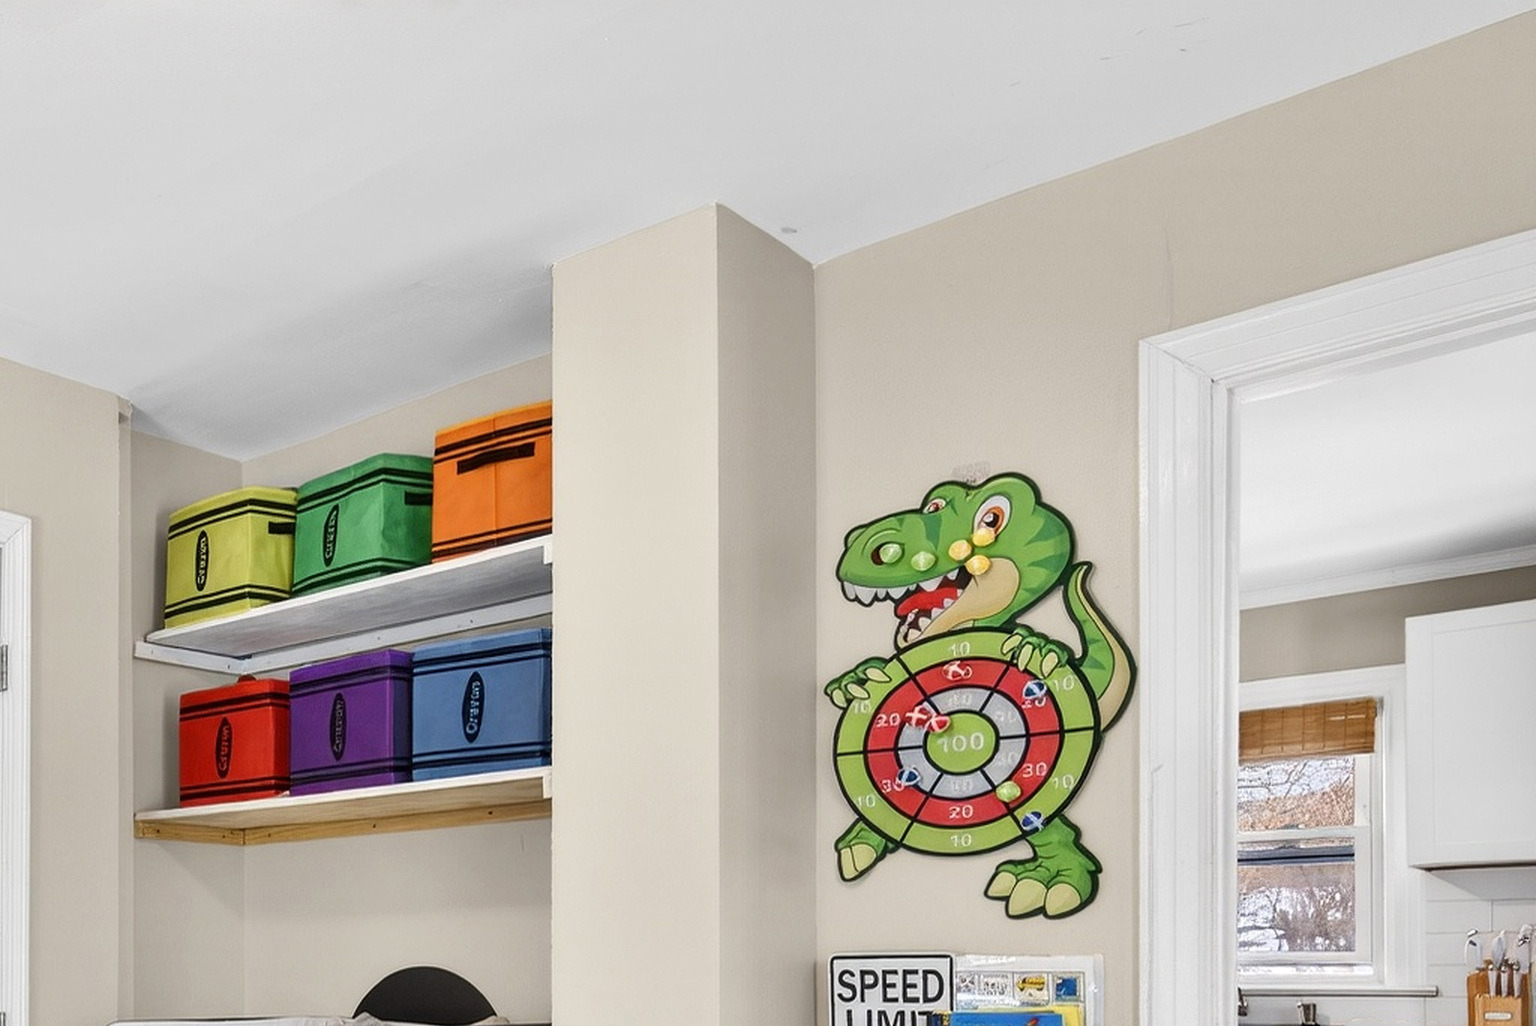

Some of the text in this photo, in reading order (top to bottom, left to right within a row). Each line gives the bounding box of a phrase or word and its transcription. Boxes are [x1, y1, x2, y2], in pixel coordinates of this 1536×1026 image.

[949, 641, 971, 657] 10
[1053, 675, 1075, 692] 10
[875, 712, 901, 728] 20
[937, 732, 984, 753] 100
[1022, 762, 1048, 778] 30
[1052, 774, 1075, 790] 10
[856, 794, 876, 808] 10
[948, 804, 974, 819] 20
[950, 834, 972, 847] 10
[837, 969, 944, 1003] SPEED
